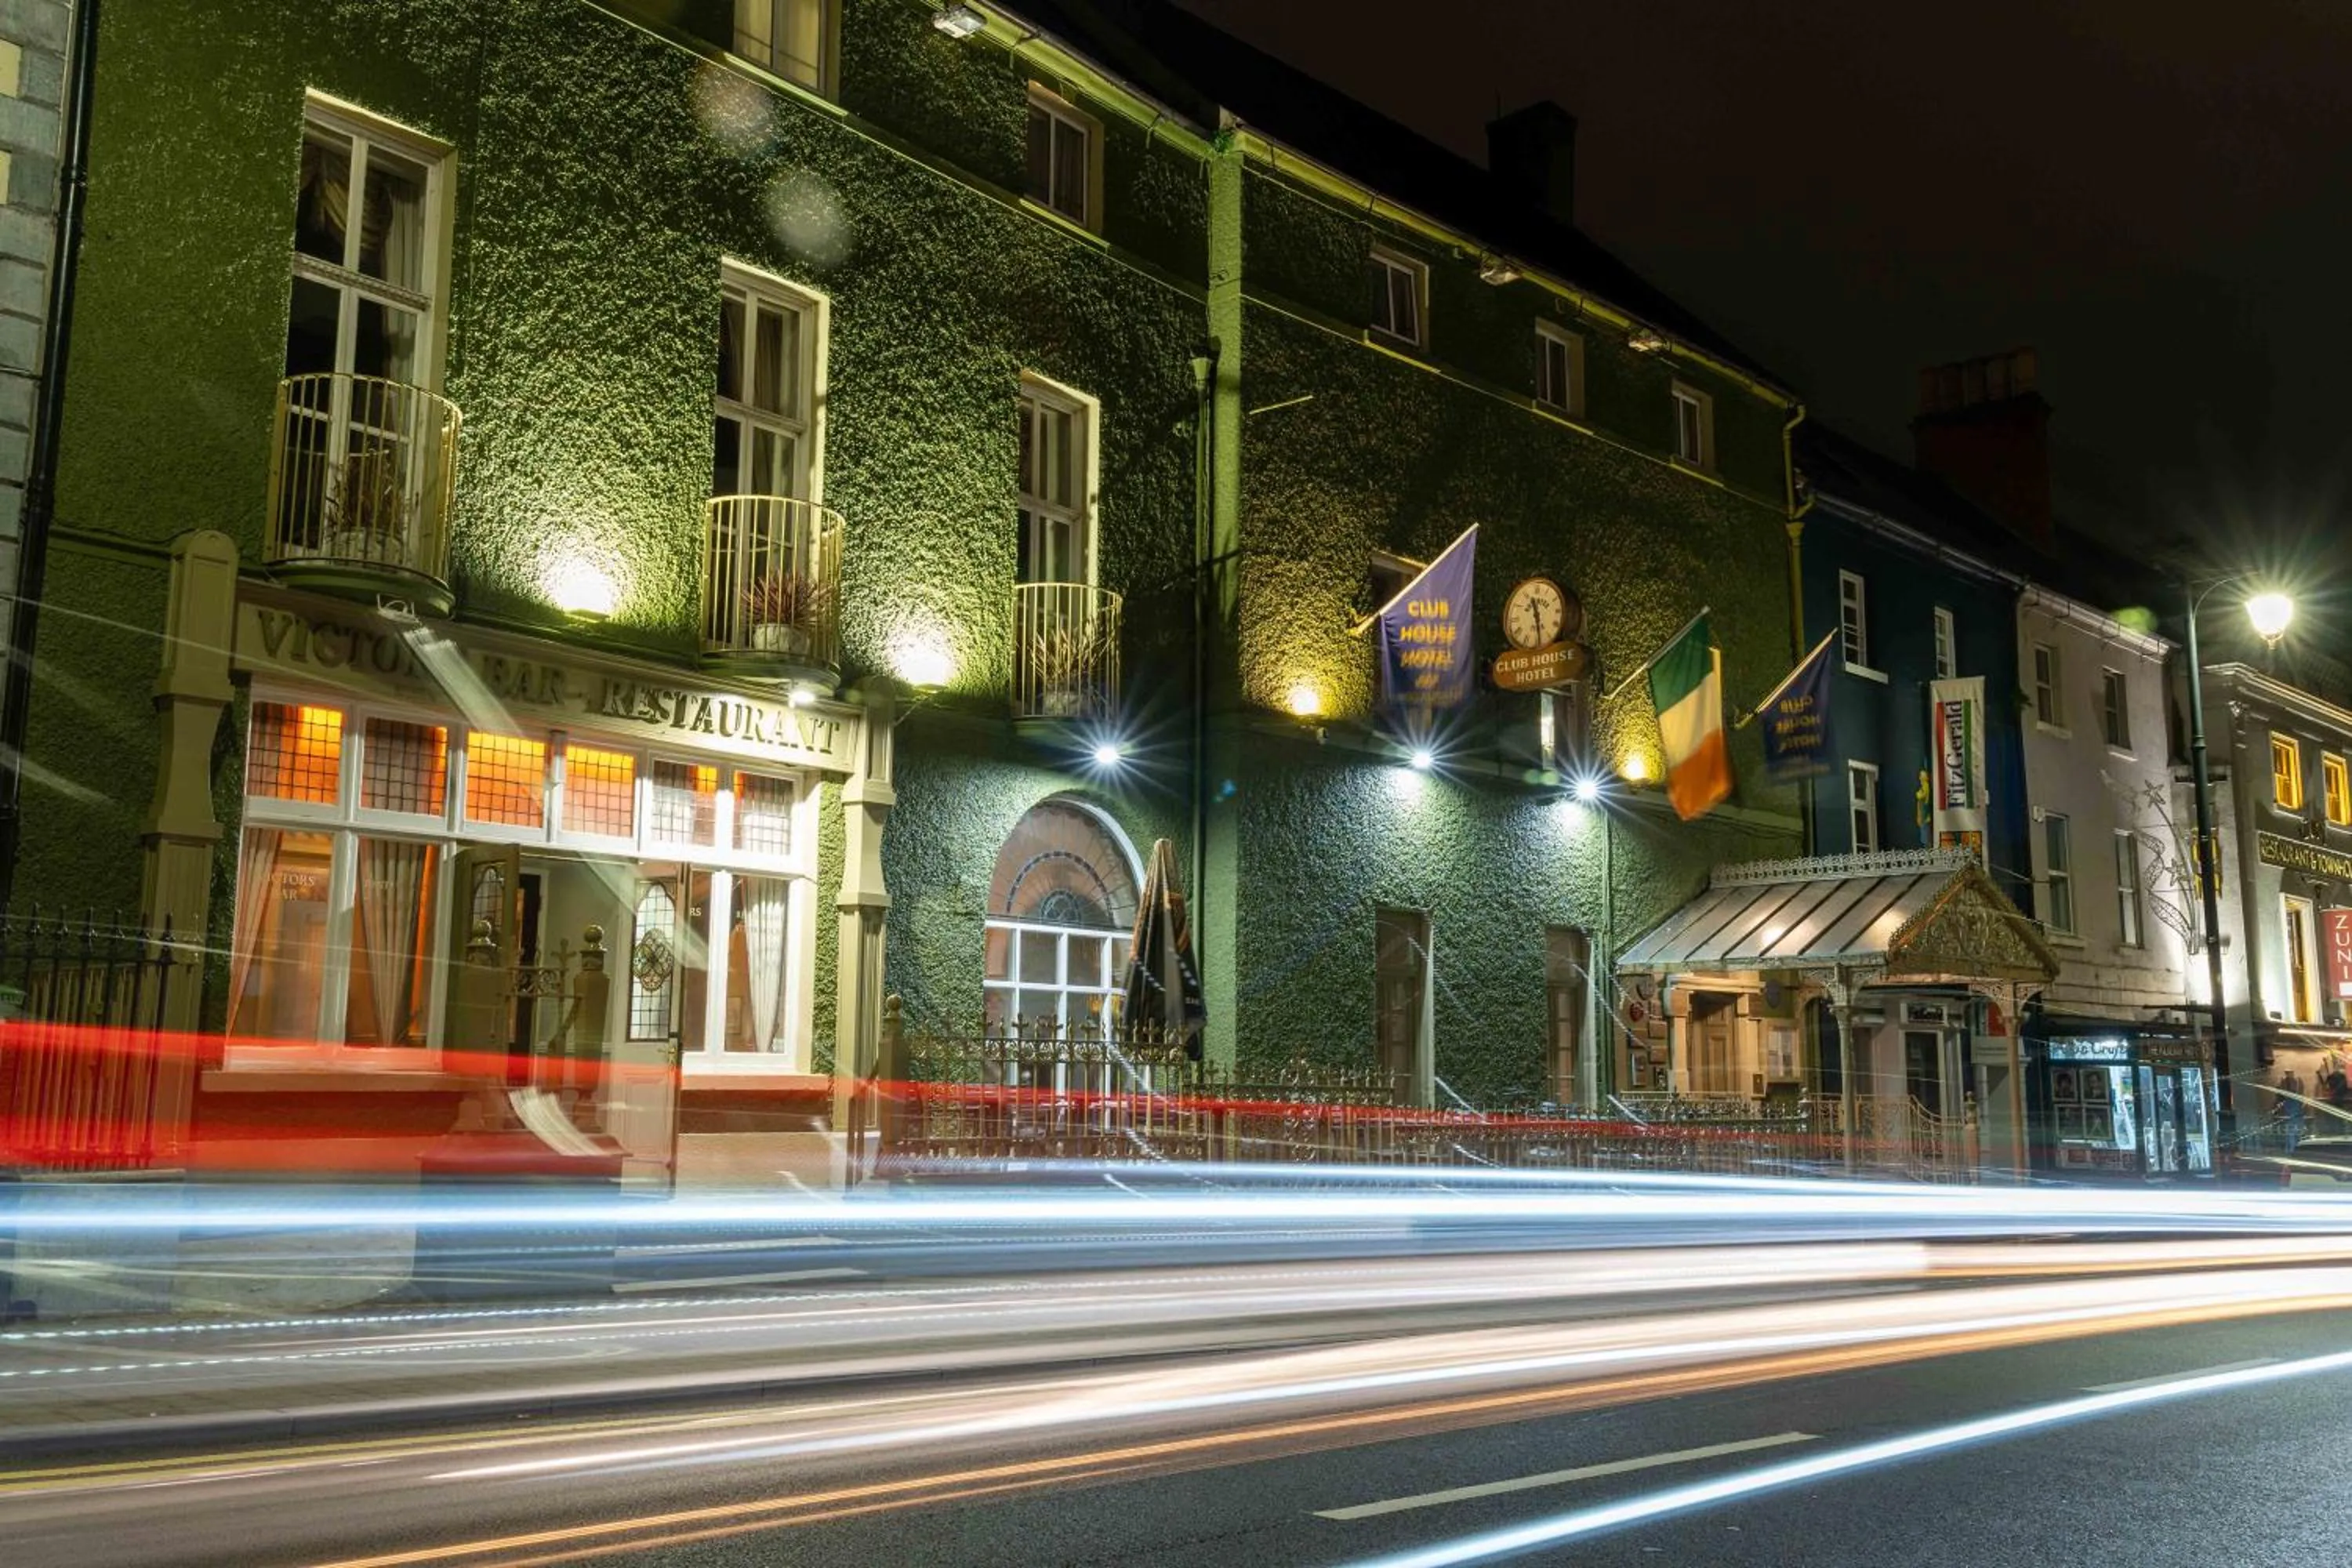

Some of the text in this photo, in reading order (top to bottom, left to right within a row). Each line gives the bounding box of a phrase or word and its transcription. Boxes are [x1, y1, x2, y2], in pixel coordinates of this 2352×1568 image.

[1408, 599, 1449, 619] CLUB
[1400, 622, 1457, 644] HOUSE
[1400, 648, 1455, 670] HOTEL
[1496, 648, 1574, 673] CLUB HOUSE
[1515, 666, 1555, 684] HOTEL
[601, 677, 840, 754] RESTAURANT
[1945, 699, 1965, 808] FitzGerald
[2336, 915, 2352, 978] ZUNI
